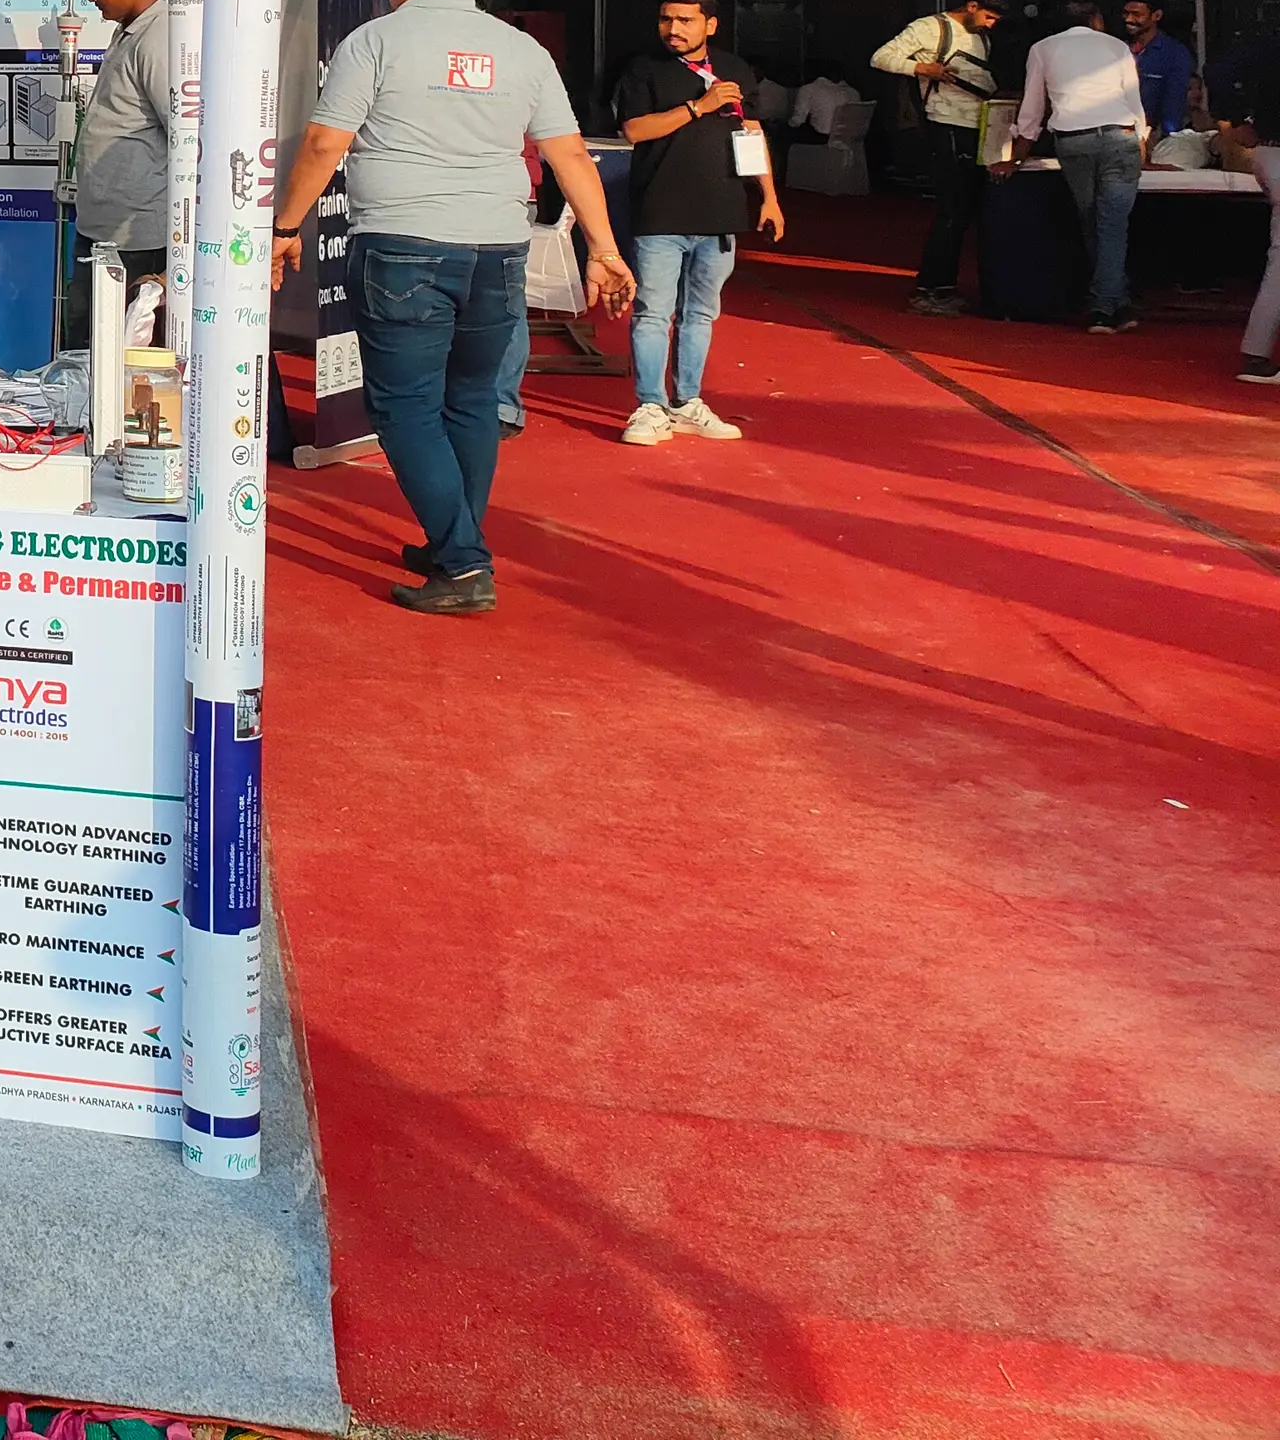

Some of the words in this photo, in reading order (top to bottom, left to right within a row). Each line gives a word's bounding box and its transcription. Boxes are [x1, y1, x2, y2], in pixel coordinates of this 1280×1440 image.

[10, 530, 187, 568] ELECTRODES
[18, 573, 38, 592] &
[81, 824, 172, 847] ADVANCED
[82, 845, 167, 866] EARTHING
[44, 879, 155, 903] GUARANTEED
[24, 895, 108, 918] EARTHING
[25, 934, 145, 961] MAINTENANCE
[49, 976, 133, 997] EARTHING
[56, 1014, 128, 1036] GREATER
[55, 1035, 125, 1056] SURFACE
[129, 1043, 172, 1061] AREA
[26, 1089, 70, 1103] PRADESH
[79, 1096, 135, 1111] KARNATAKA
[146, 1104, 182, 1117] RAJAST
